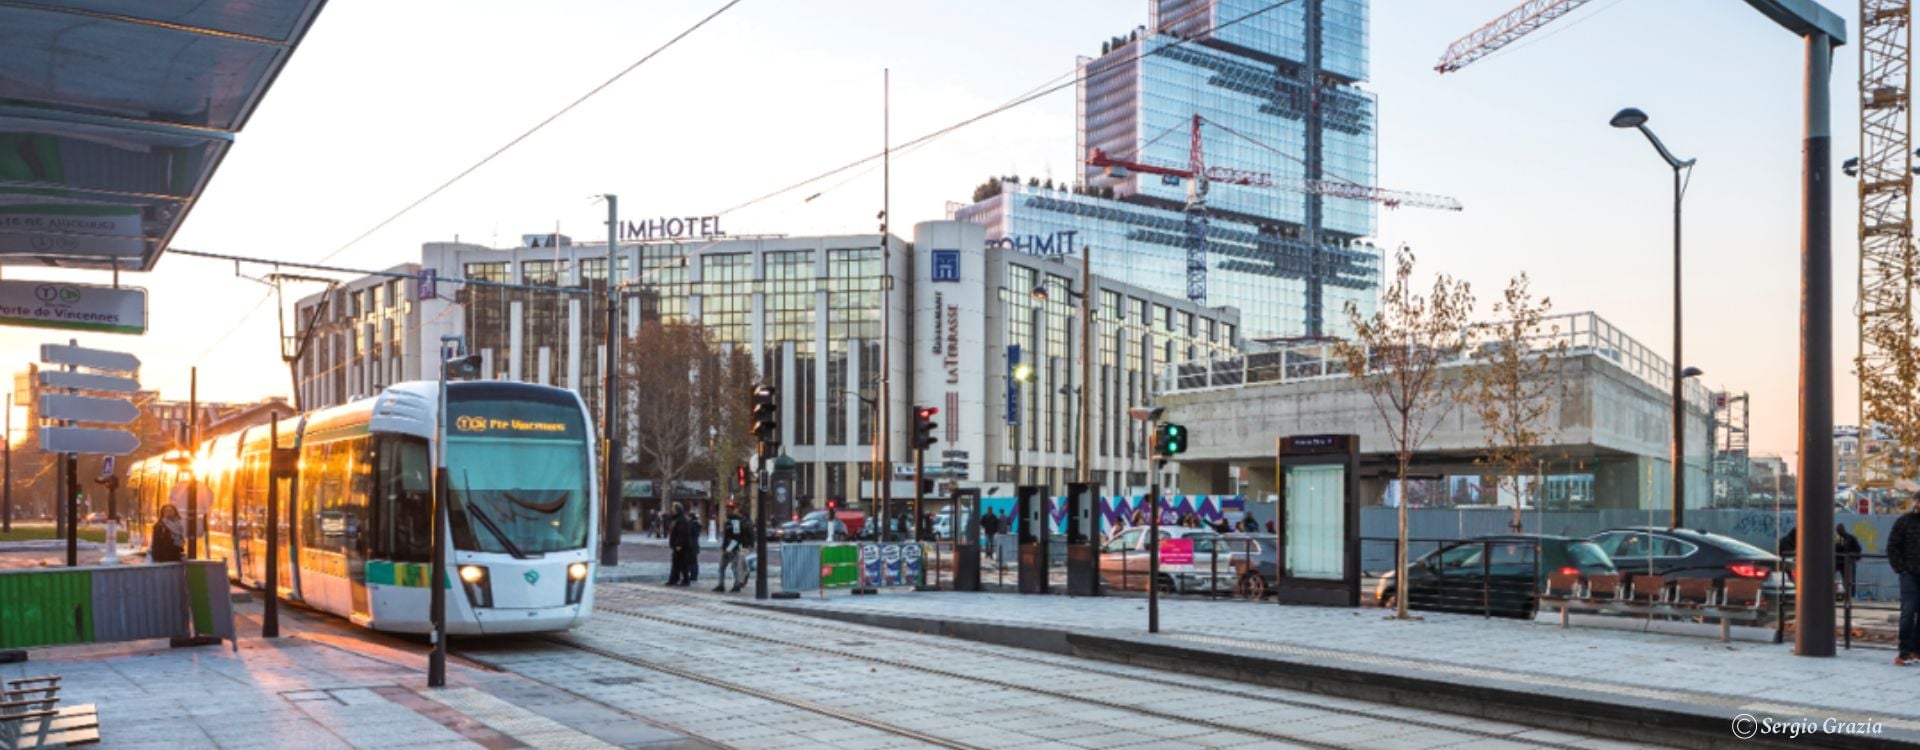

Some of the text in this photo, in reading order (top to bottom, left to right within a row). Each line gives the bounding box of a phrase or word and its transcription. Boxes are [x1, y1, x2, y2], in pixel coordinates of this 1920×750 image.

[619, 216, 726, 239] IMHOTEL
[34, 307, 50, 317] de
[55, 309, 119, 322] Vincennes
